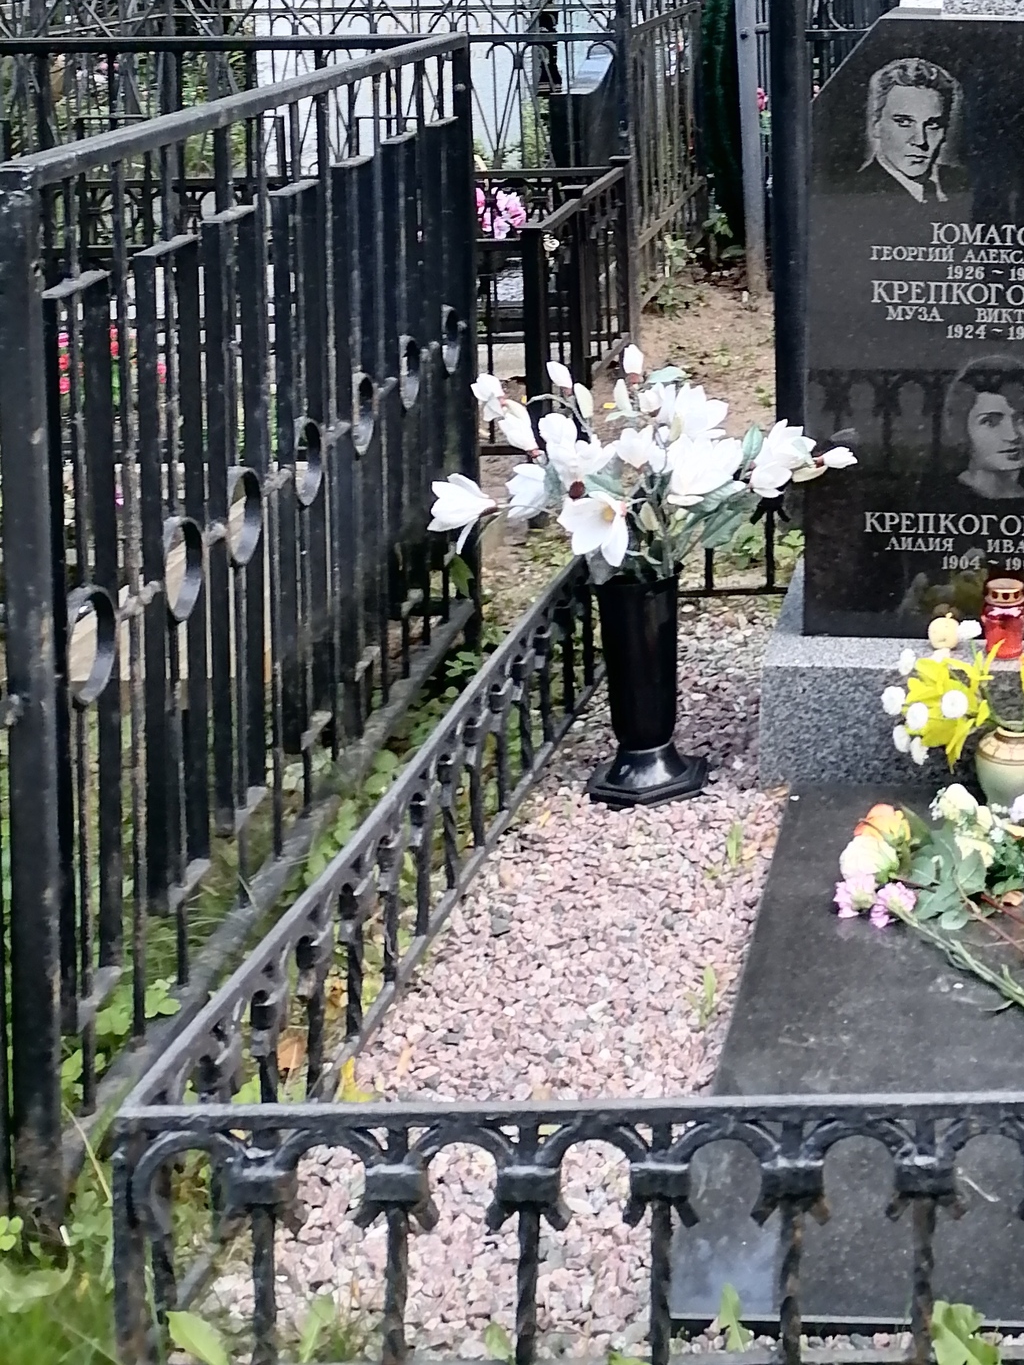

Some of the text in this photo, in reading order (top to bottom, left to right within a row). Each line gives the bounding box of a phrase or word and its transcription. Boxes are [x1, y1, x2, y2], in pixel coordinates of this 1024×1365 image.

[869, 244, 955, 263] ГЕОРГИЙ
[946, 265, 985, 281] 1926
[885, 305, 944, 322] МУЗА
[946, 324, 987, 339] 1924
[885, 536, 955, 552] ЛИДИЯ
[941, 554, 981, 570] 1904
